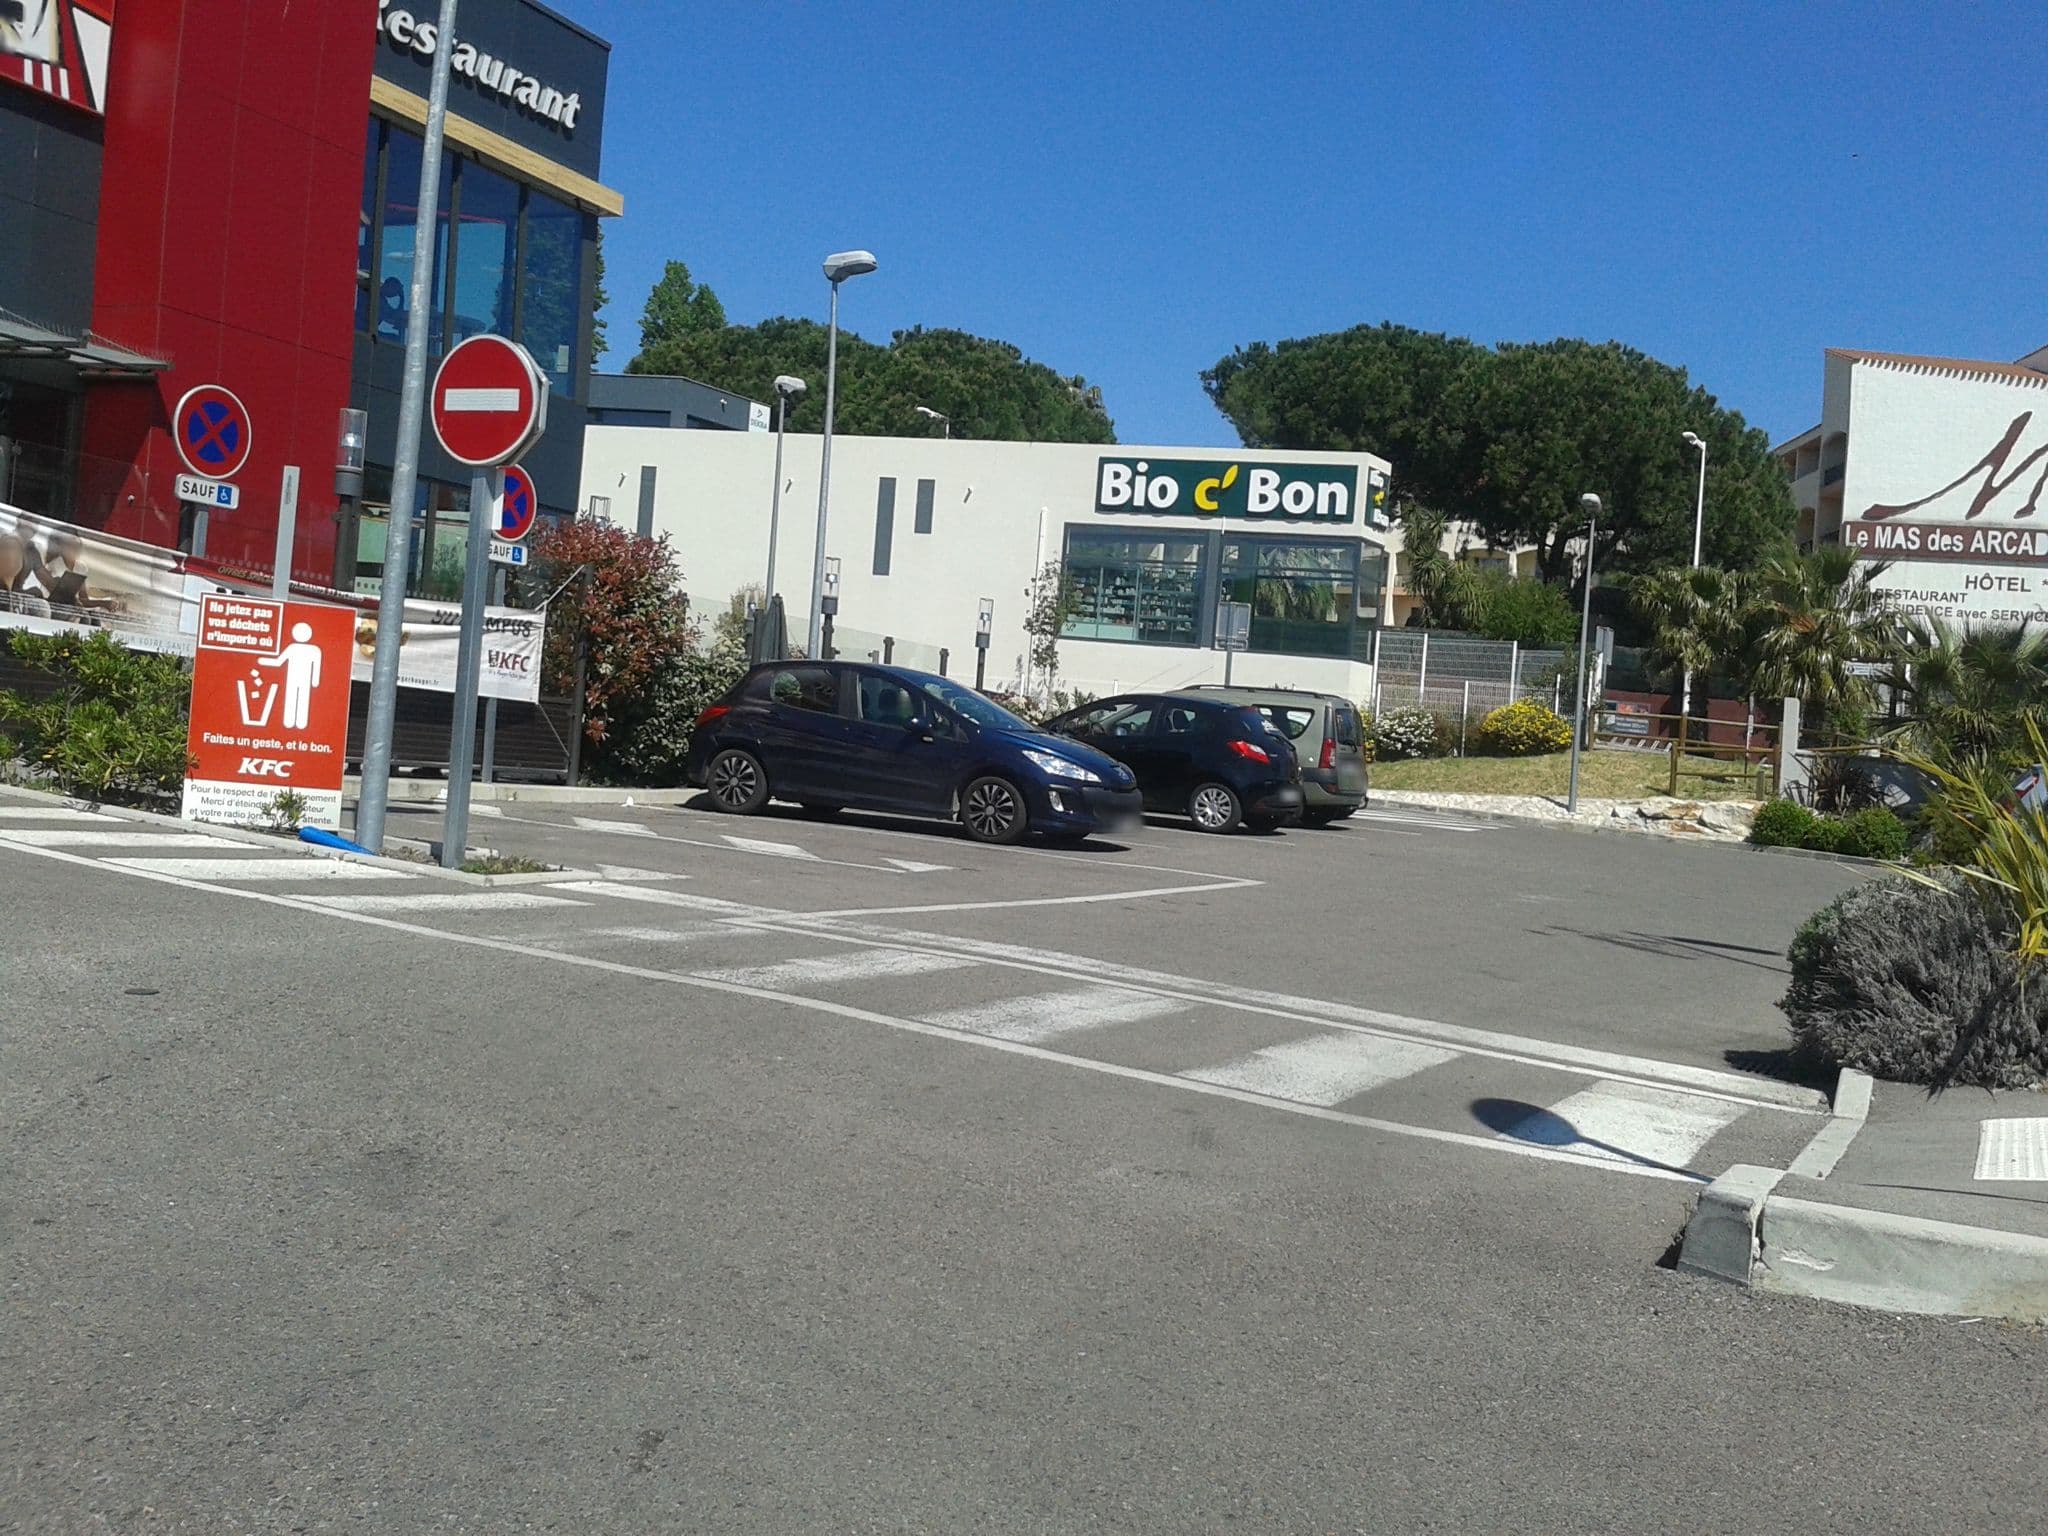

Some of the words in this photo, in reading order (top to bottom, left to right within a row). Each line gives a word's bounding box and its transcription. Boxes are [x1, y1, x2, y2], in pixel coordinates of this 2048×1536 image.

[182, 480, 216, 499] SAUF
[1099, 461, 1179, 509] Bio
[1247, 469, 1349, 516] Bon
[1845, 523, 1870, 548] Le
[1874, 525, 1921, 550] MAS
[1927, 527, 1964, 552] des
[1964, 572, 2032, 593] HÔTEL
[209, 601, 224, 612] Ne
[225, 602, 251, 616] jetez
[253, 608, 273, 619] pas
[1956, 609, 1987, 619] avec
[208, 617, 227, 628] vos
[229, 618, 270, 632] déchets
[206, 631, 257, 645] n'importe
[259, 635, 273, 647] où
[499, 651, 531, 673] KFC
[203, 732, 235, 745] Faites
[237, 737, 250, 746] un
[252, 738, 284, 751] geste,
[286, 741, 296, 750] et
[298, 741, 308, 751] le
[310, 742, 333, 754] bon.
[238, 757, 295, 778] KFC
[190, 784, 211, 794] Pour
[213, 785, 221, 794] le
[223, 787, 255, 797] respect
[257, 789, 268, 797] de
[200, 796, 225, 805] Merci
[189, 808, 198, 816] et
[200, 809, 222, 817] votre
[223, 810, 245, 818] radio
